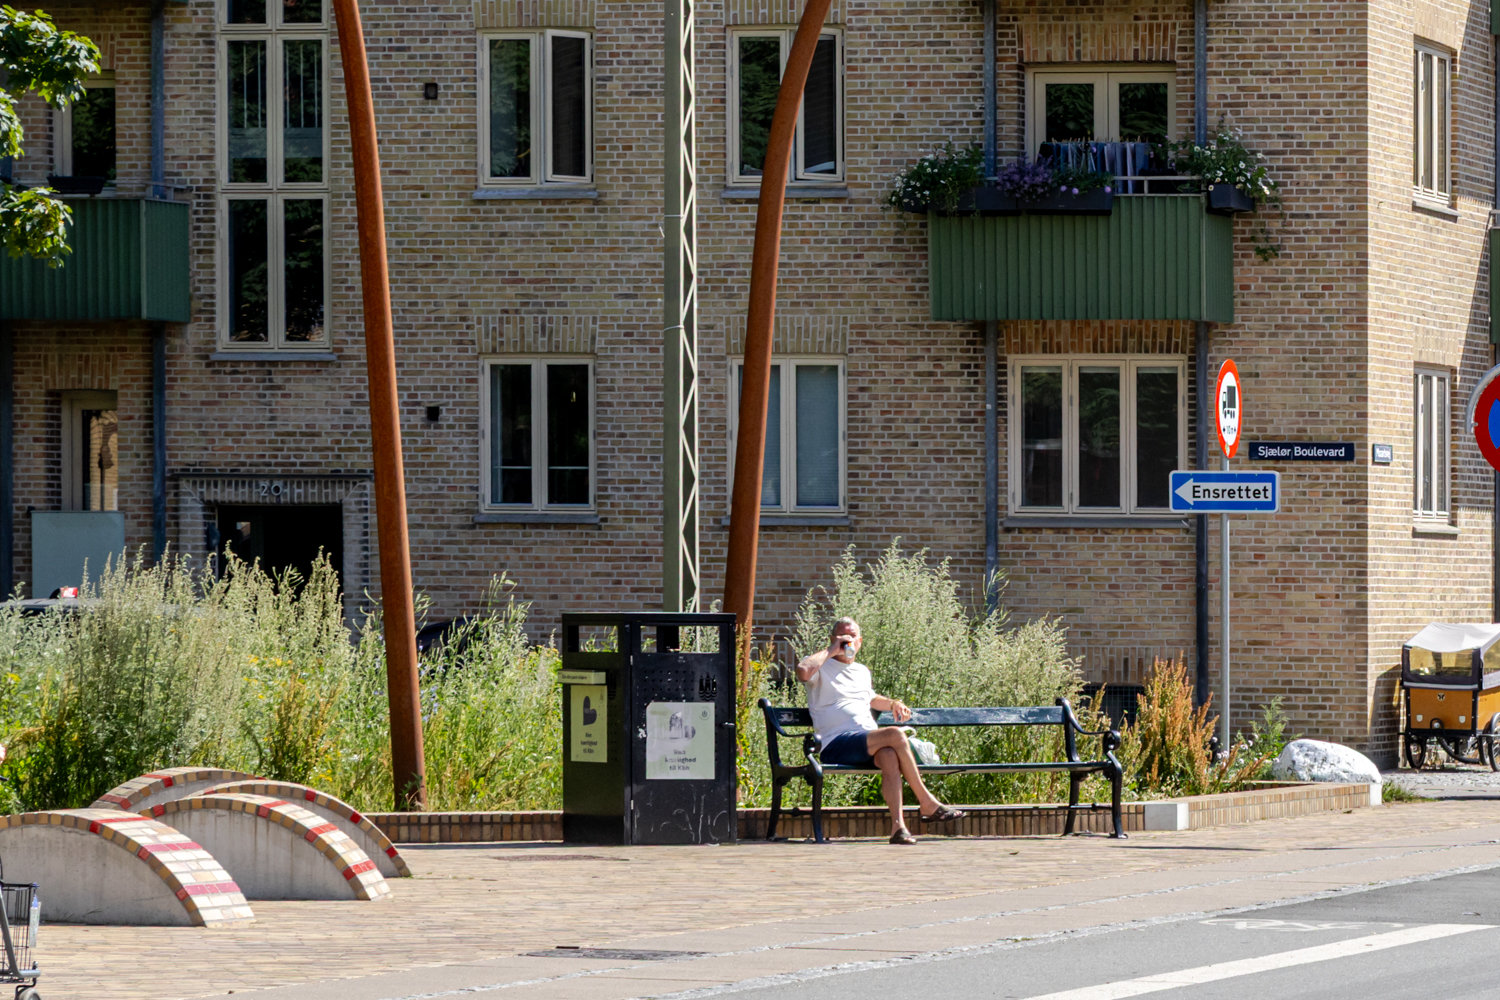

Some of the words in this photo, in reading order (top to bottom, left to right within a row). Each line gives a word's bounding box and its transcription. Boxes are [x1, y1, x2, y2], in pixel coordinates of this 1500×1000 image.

[1258, 446, 1291, 458] Sjælør
[1294, 446, 1345, 457] Boulevard
[260, 483, 282, 496] 20
[1192, 485, 1269, 499] Ensrettet
